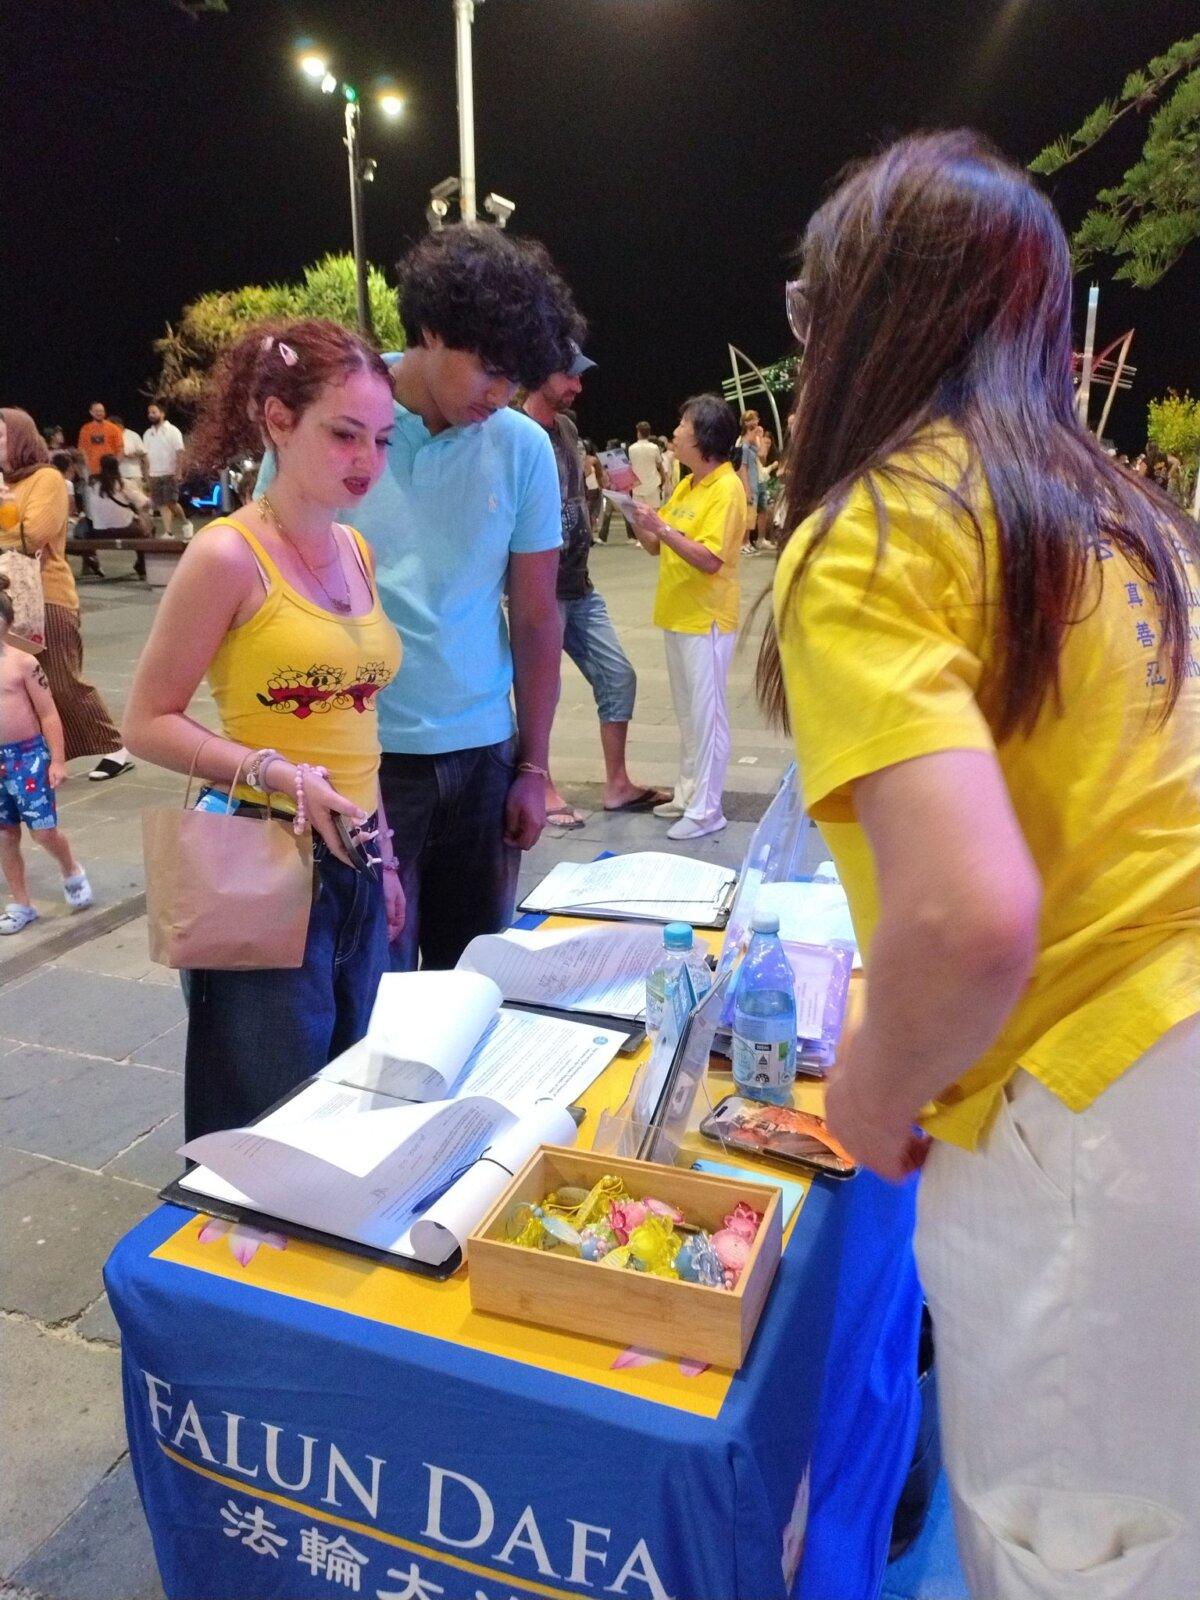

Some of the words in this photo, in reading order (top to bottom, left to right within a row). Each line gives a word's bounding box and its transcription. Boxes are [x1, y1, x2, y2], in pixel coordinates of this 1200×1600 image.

[140, 1369, 386, 1520] FALUN
[420, 1462, 677, 1600] DAFA
[219, 1499, 524, 1600] 法輪大
